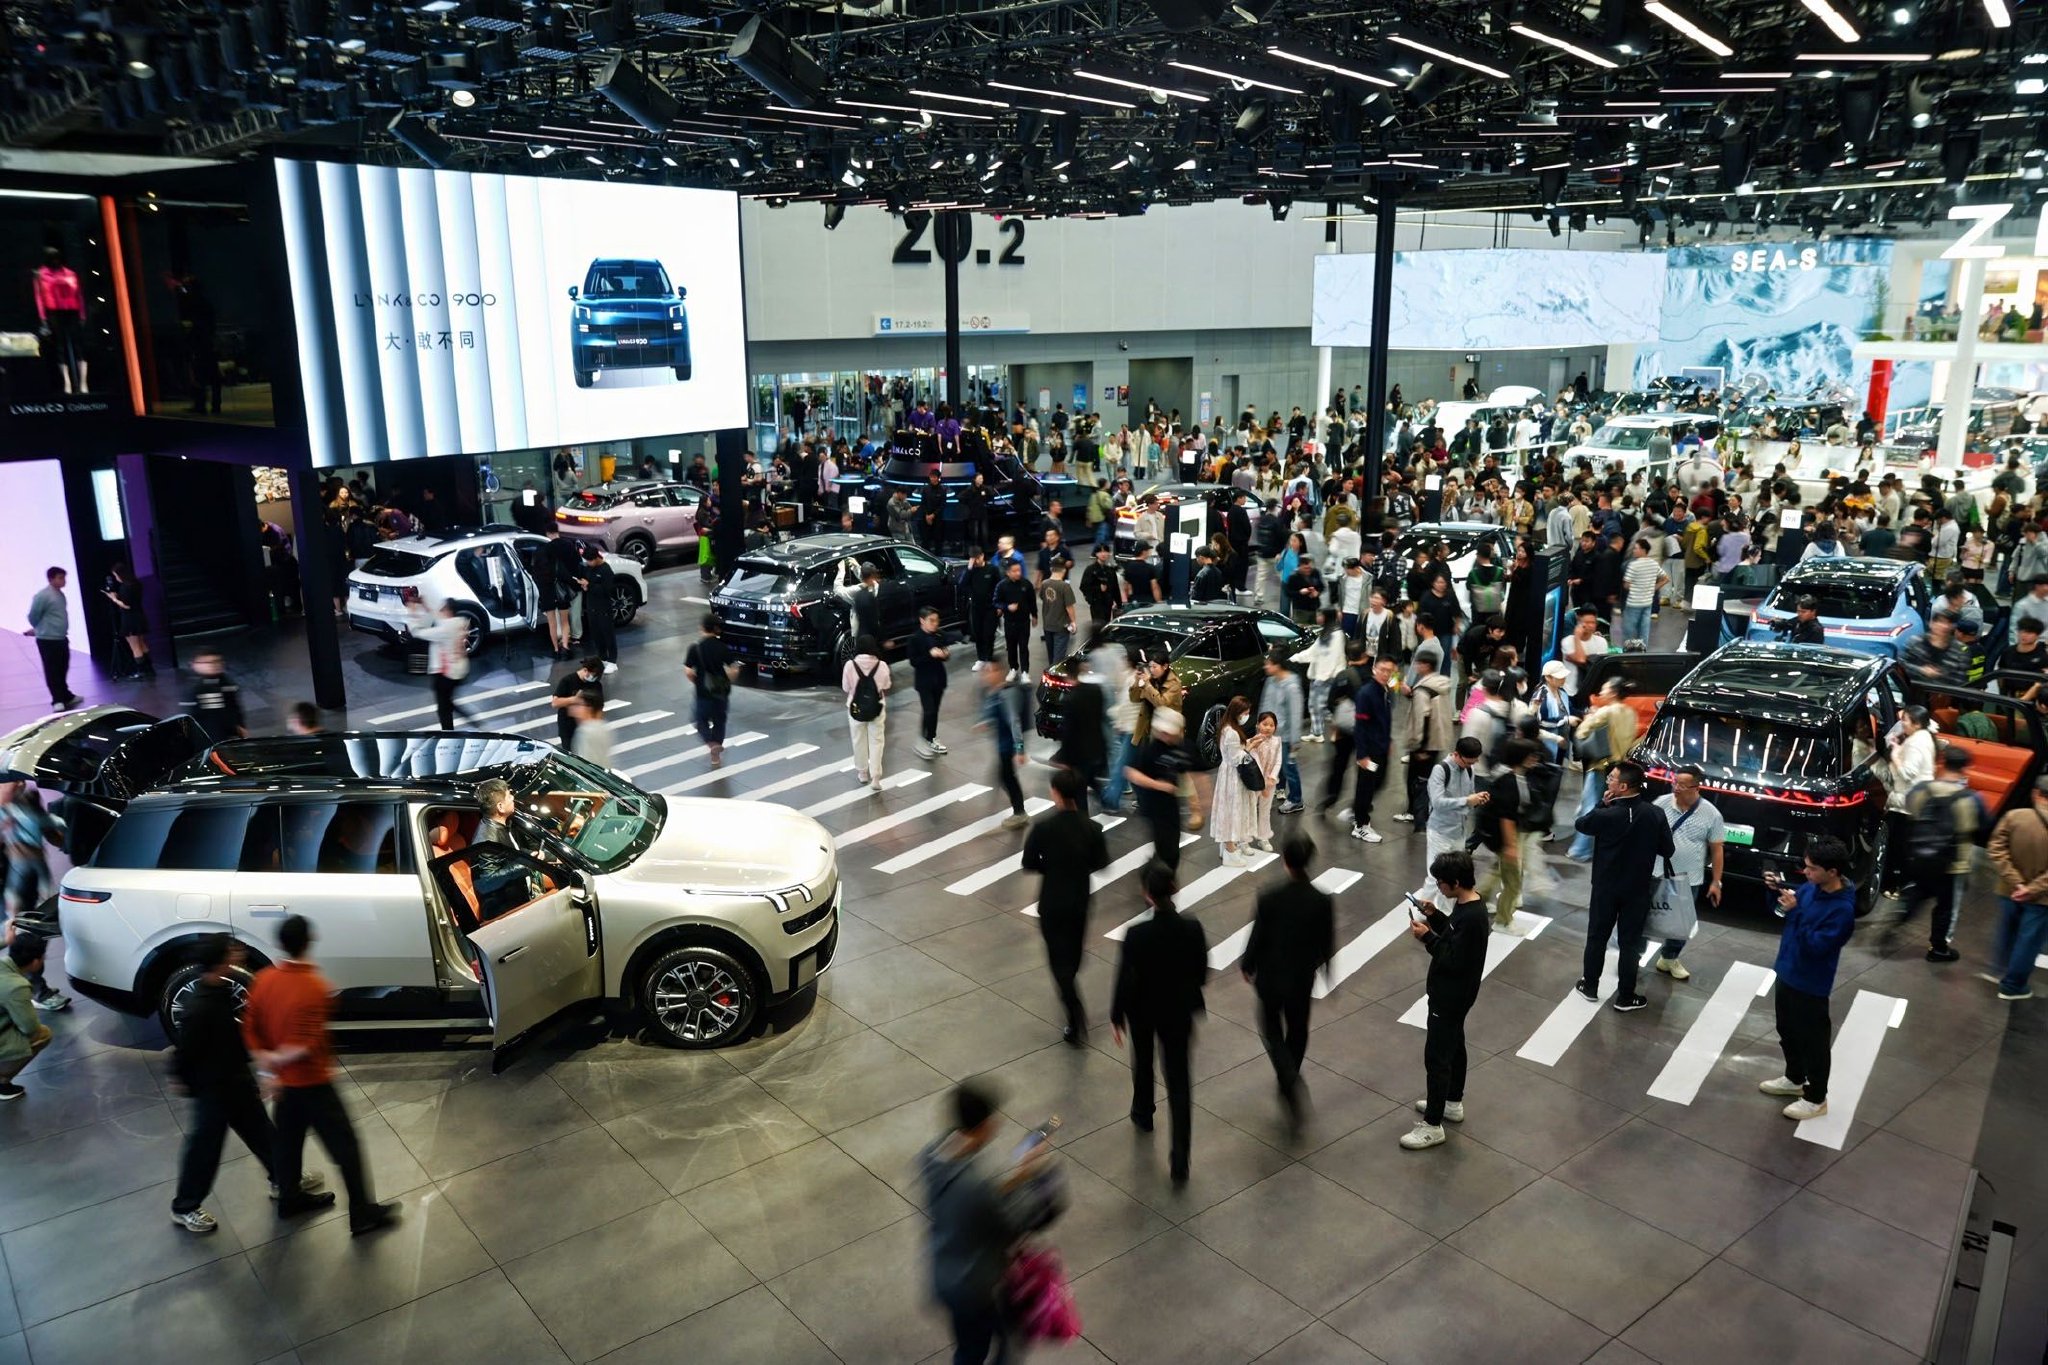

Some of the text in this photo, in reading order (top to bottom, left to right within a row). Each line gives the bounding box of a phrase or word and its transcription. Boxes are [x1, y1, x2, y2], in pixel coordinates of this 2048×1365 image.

[892, 210, 1025, 264] 20.2
[1731, 247, 1817, 272] SEA-S
[452, 293, 496, 307] 900
